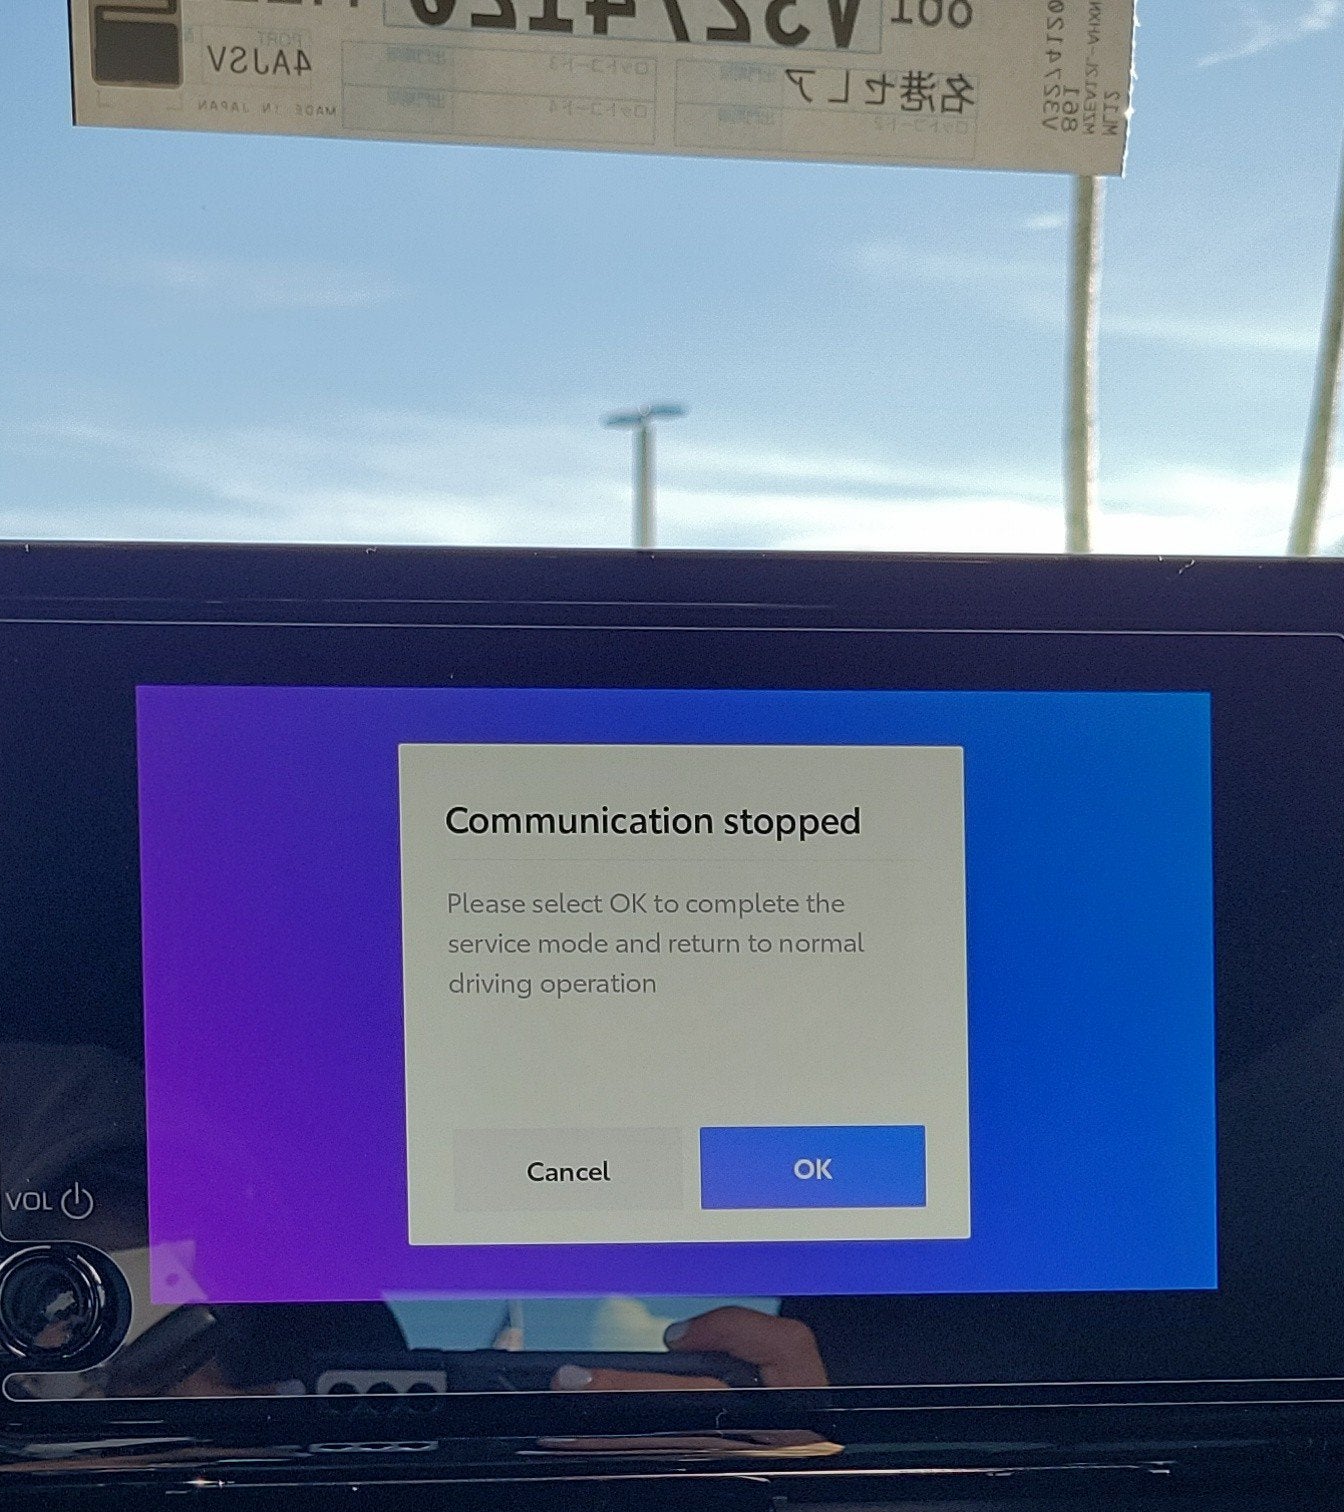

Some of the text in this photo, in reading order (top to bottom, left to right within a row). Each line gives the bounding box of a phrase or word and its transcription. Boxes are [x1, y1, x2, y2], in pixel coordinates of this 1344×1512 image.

[444, 804, 862, 842] Communication stopped
[447, 891, 846, 920] Please select OK to complete the
[447, 932, 866, 955] service mode and return to normal
[448, 972, 657, 999] driving operation
[526, 1160, 611, 1183] Cancel
[793, 1159, 834, 1182] OK
[4, 1190, 53, 1211] VOL
